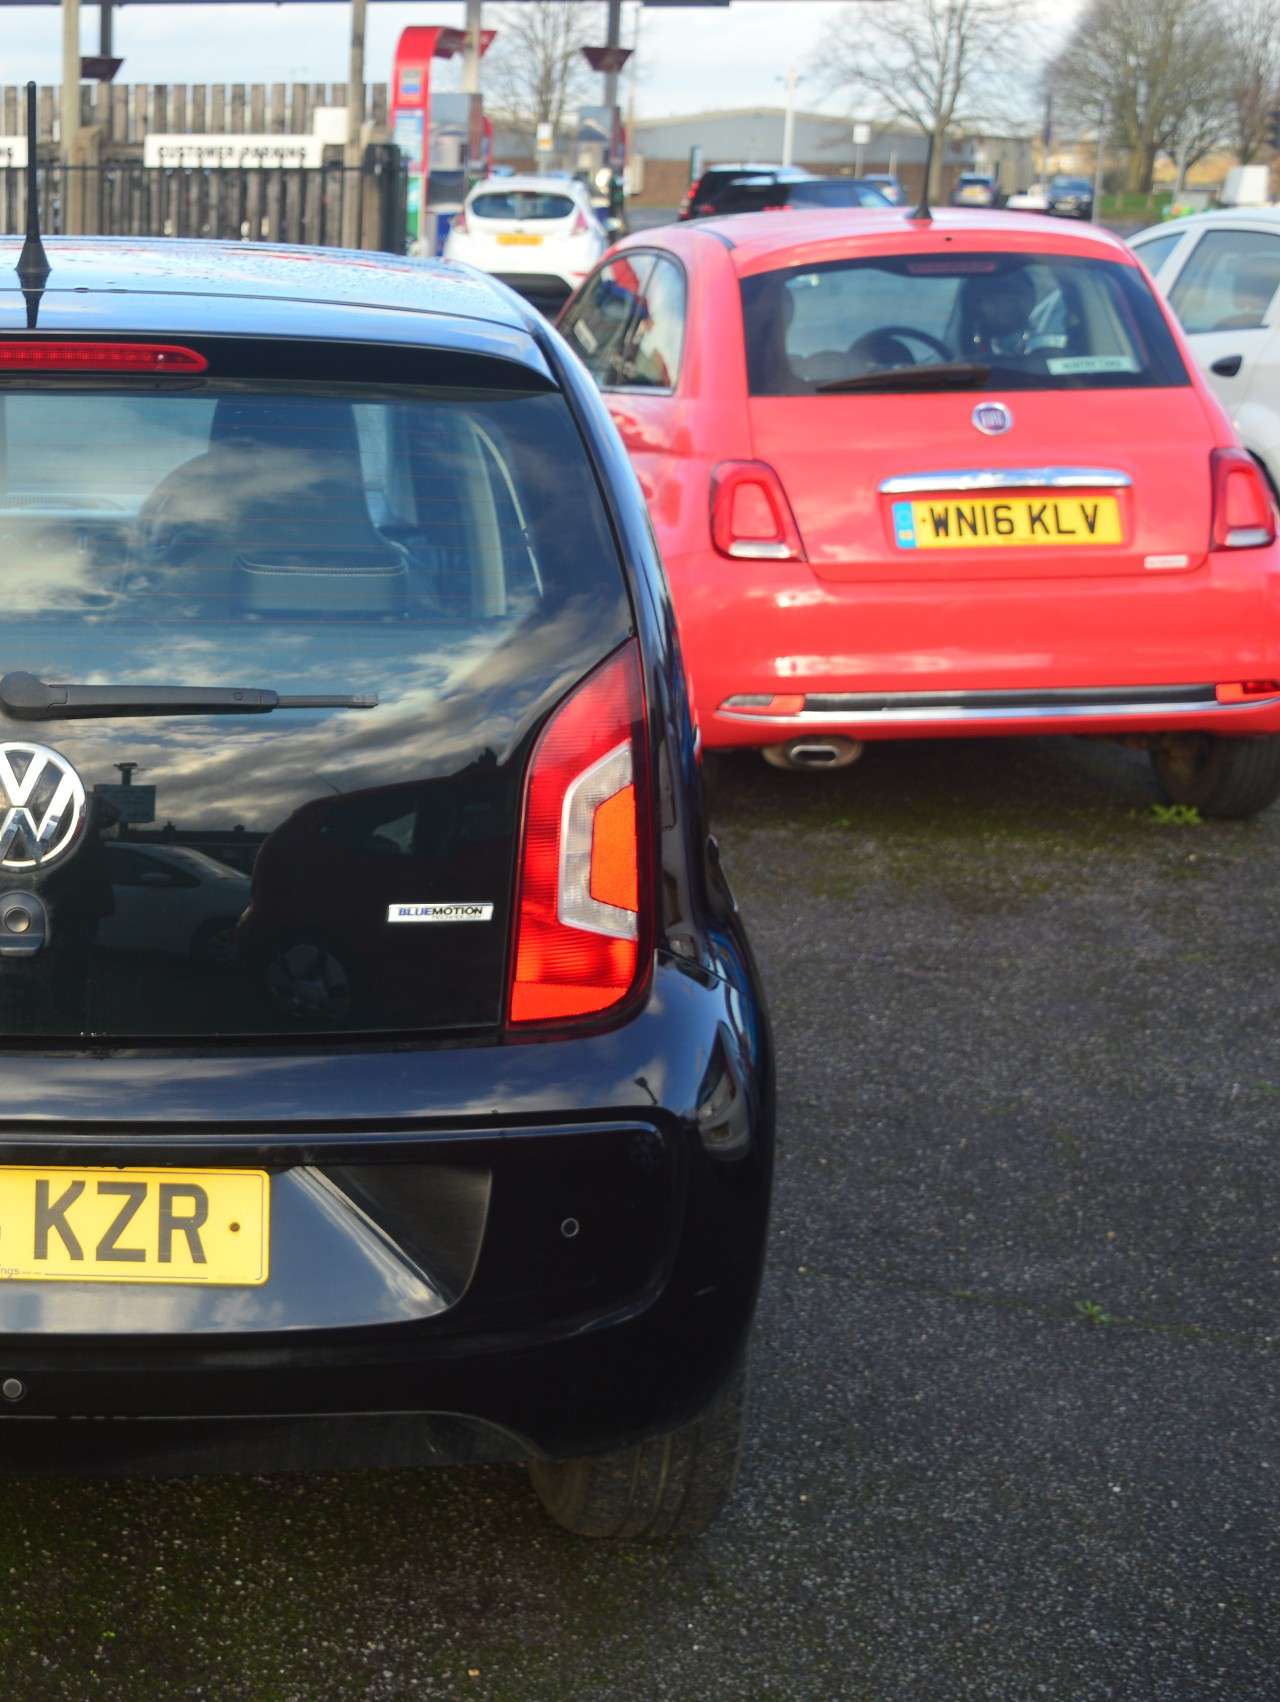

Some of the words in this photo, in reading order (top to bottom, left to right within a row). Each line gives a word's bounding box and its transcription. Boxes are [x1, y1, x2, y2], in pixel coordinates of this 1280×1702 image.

[158, 146, 233, 159] CUSTOMER
[239, 146, 306, 160] PARKING
[929, 505, 1015, 538] WN16
[1028, 503, 1099, 535] KLV
[398, 906, 483, 916] BLUEMOTION
[33, 1179, 210, 1264] KZR
